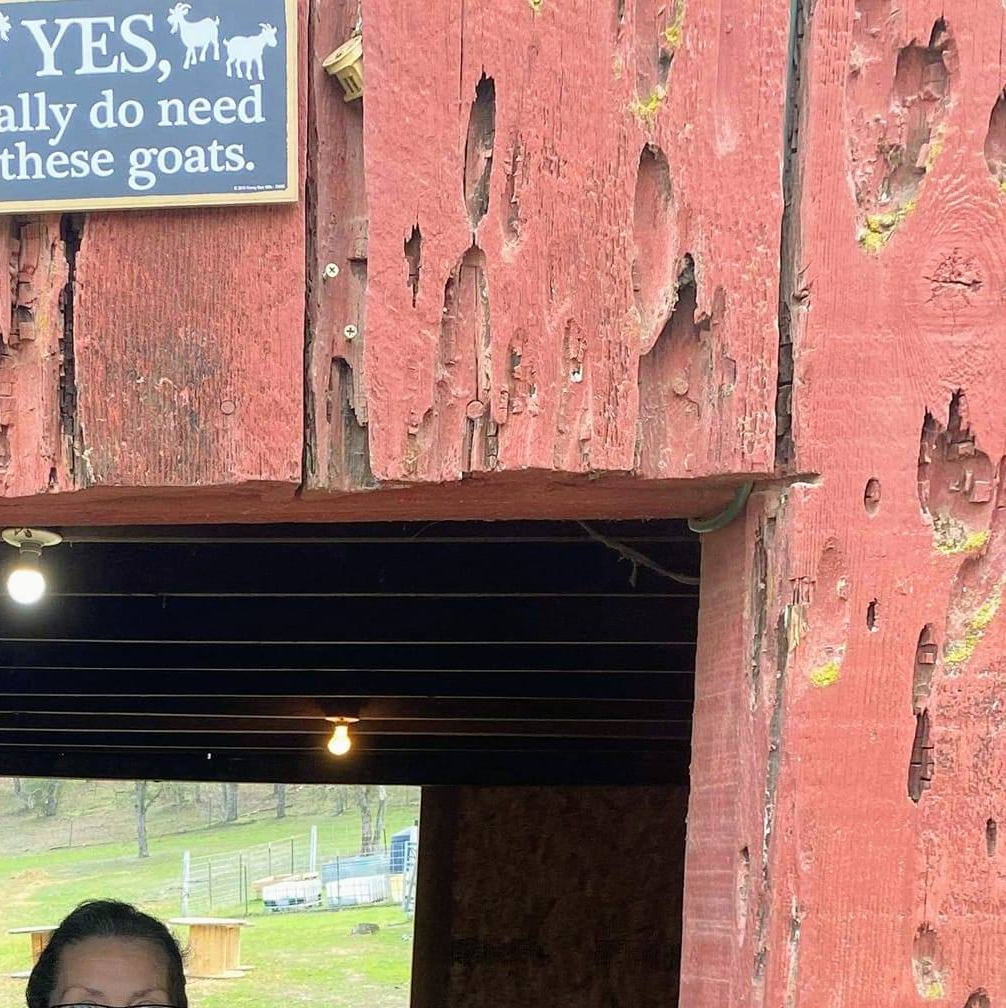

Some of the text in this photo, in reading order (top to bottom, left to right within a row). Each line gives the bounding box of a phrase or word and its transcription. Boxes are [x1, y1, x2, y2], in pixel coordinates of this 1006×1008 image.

[20, 13, 172, 83] YES,
[89, 89, 144, 129] do
[157, 84, 266, 127] need
[128, 139, 255, 191] goats.
